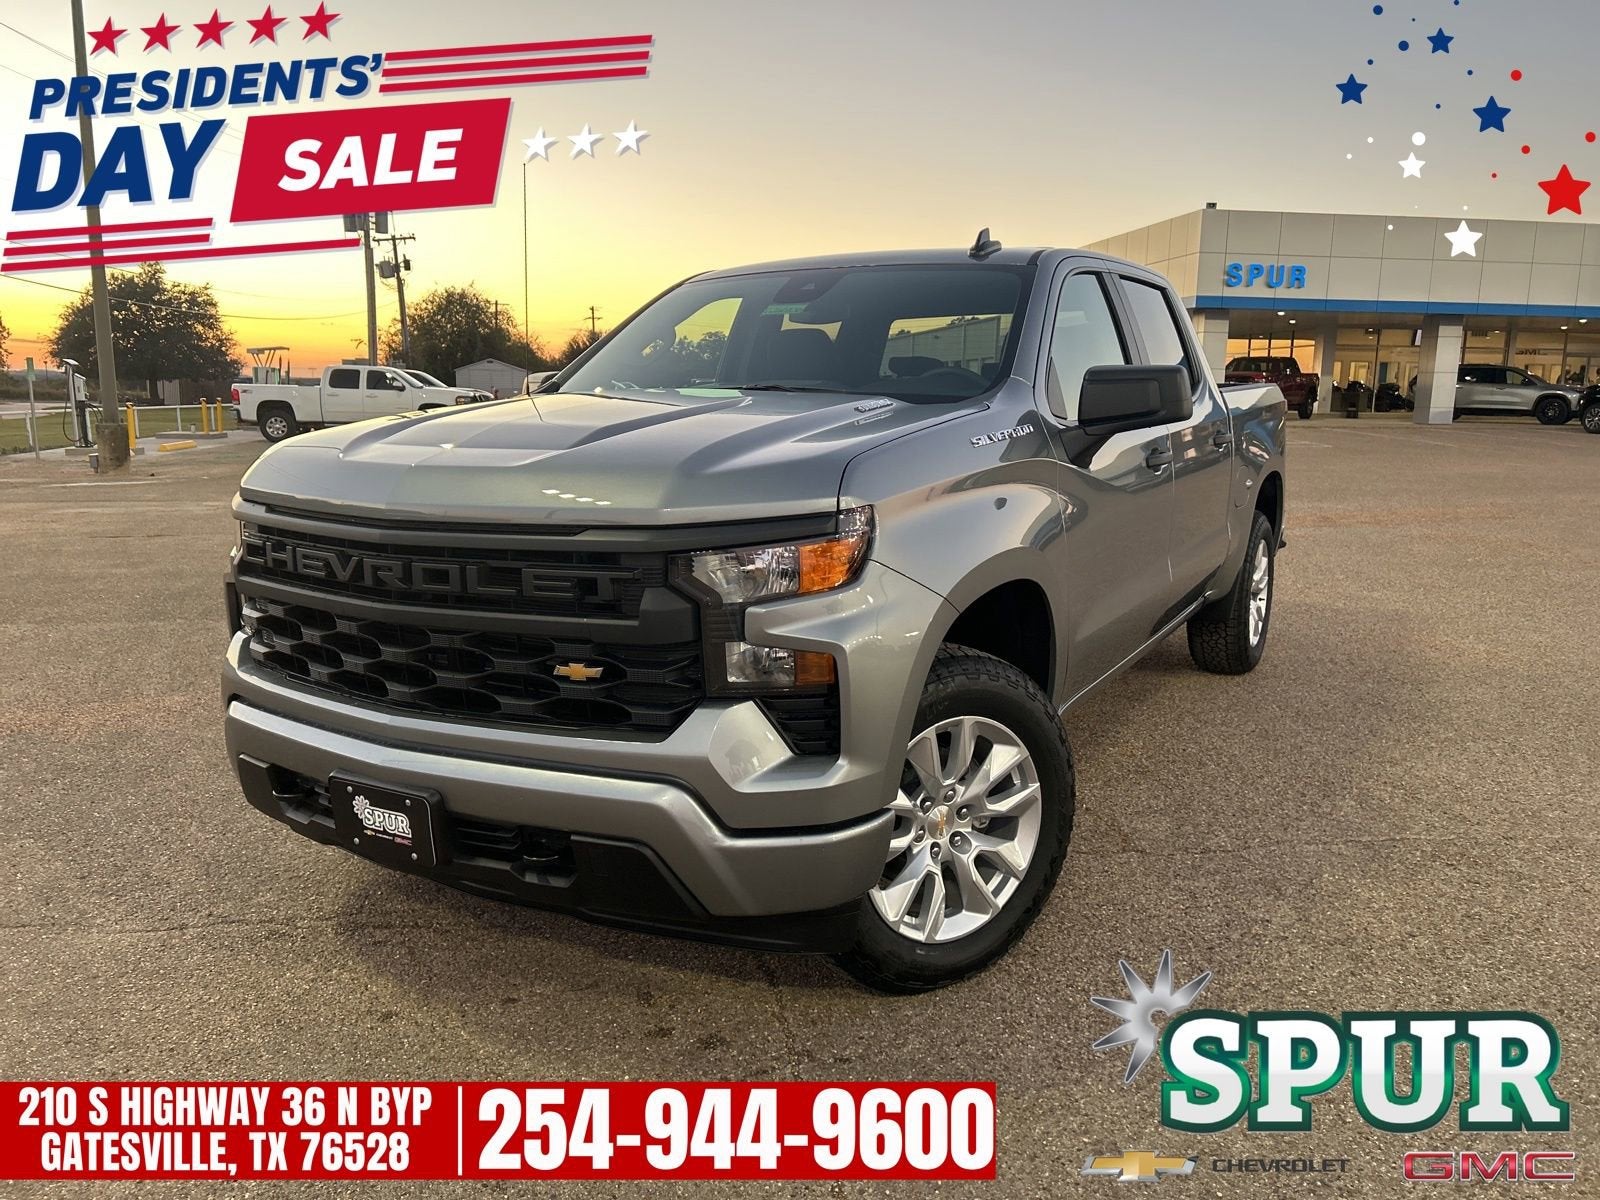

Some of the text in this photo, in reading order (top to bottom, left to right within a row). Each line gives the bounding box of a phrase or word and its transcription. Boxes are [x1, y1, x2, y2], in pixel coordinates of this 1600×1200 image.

[1225, 262, 1308, 289] SPUR
[242, 532, 646, 601] CHEVROLET
[362, 805, 412, 838] SPUR
